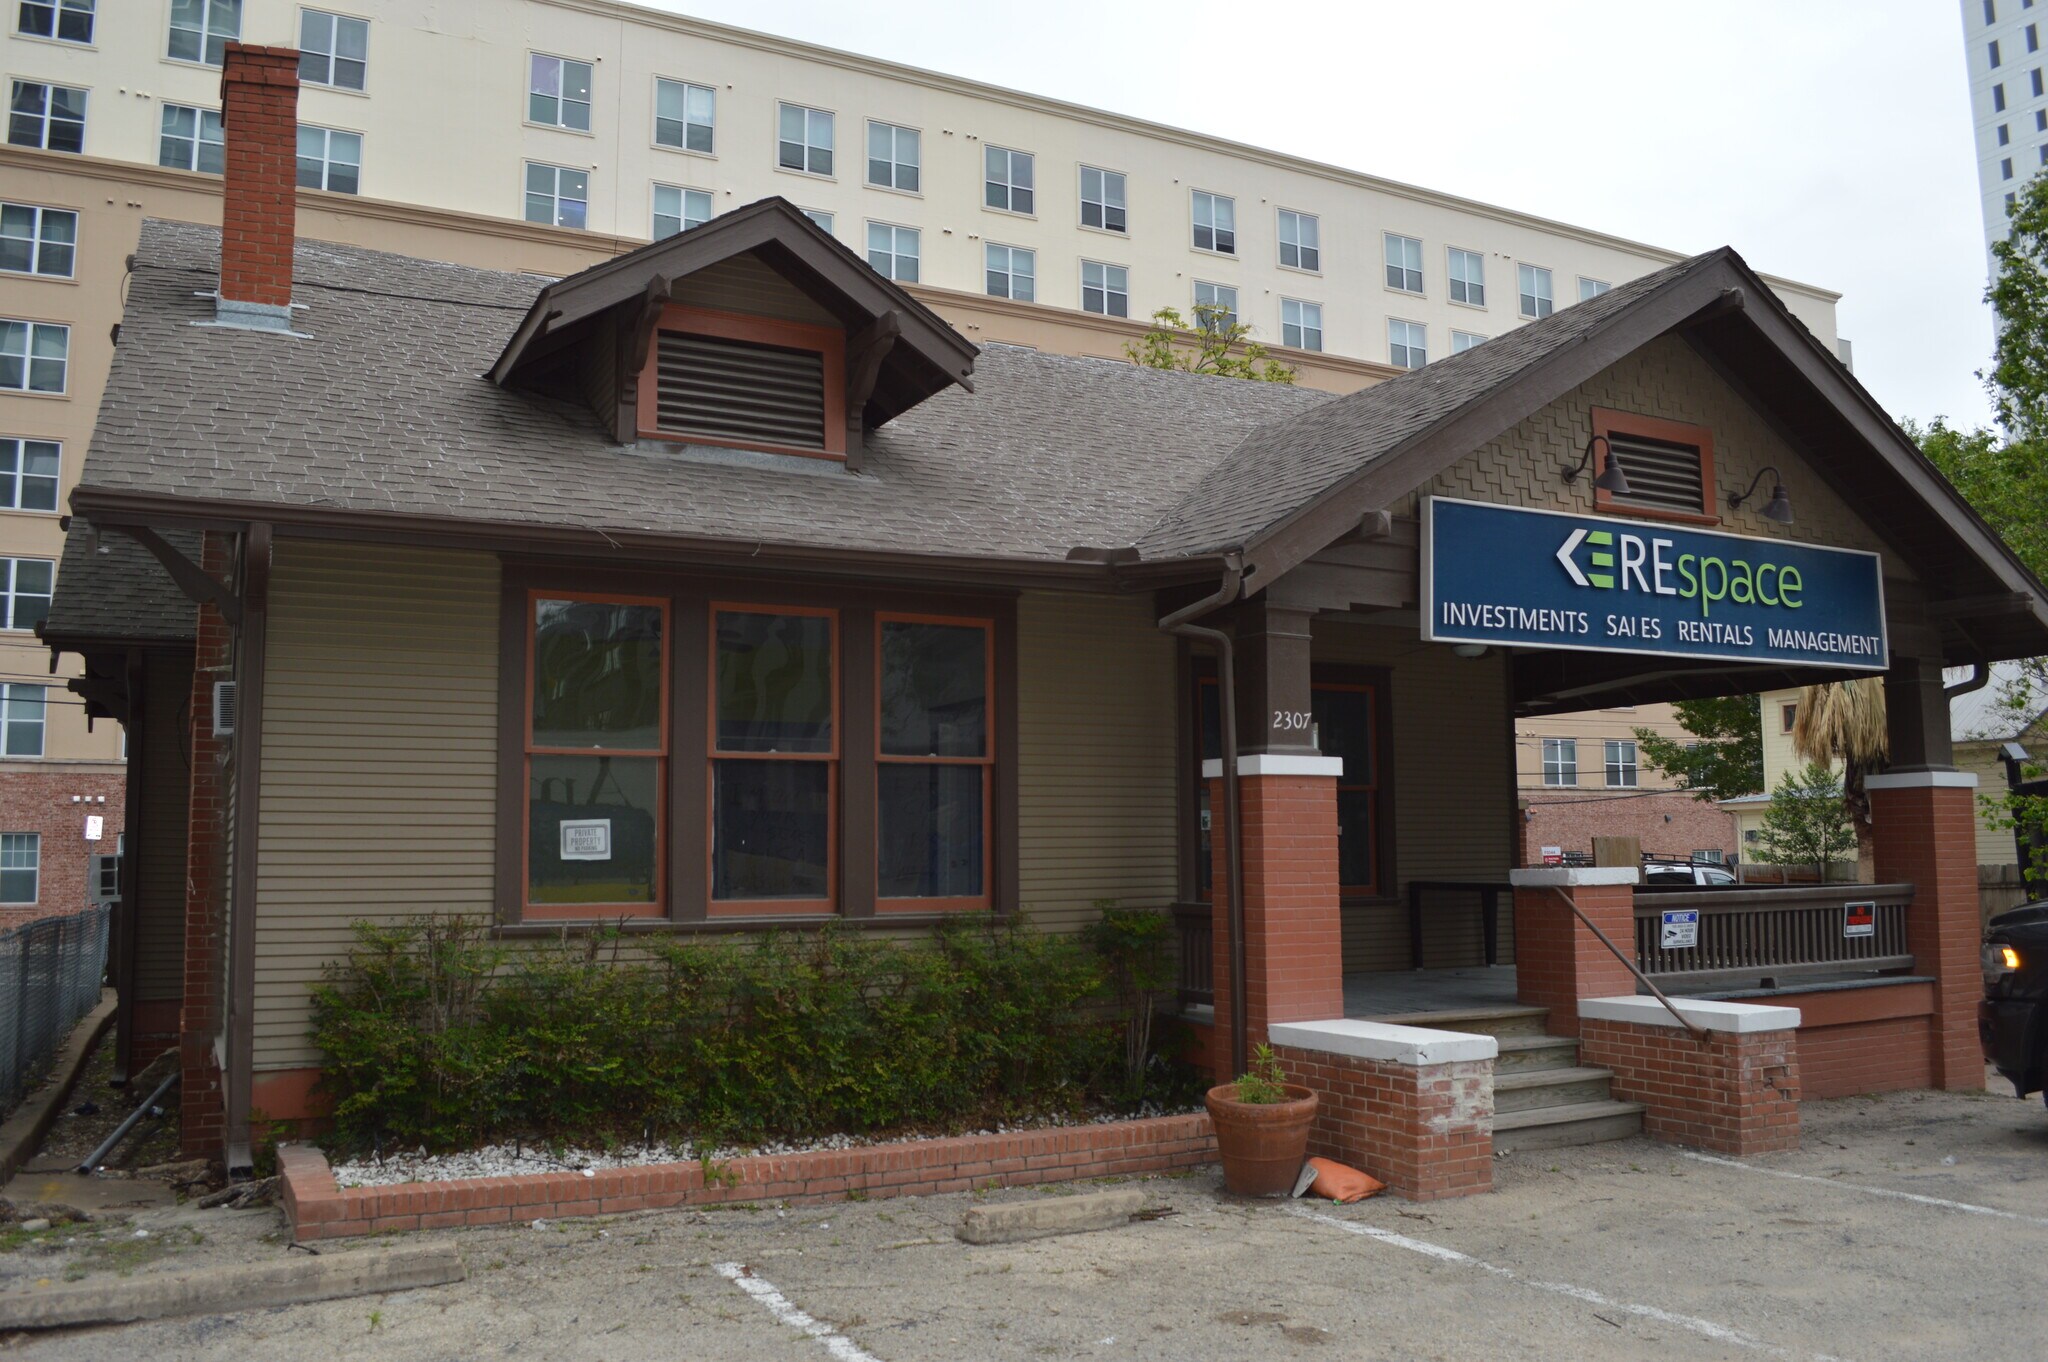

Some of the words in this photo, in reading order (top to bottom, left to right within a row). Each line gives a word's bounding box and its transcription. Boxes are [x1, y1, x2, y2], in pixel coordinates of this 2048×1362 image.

[1442, 601, 1590, 634] INVESTMENTS
[1677, 620, 1754, 646] RENTALS
[1767, 627, 1880, 656] MANAGEMENT
[1273, 711, 1312, 730] 2307
[575, 829, 597, 837] PRIVATE
[570, 837, 601, 846] PROPERTY
[1672, 913, 1690, 922] NOTICE
